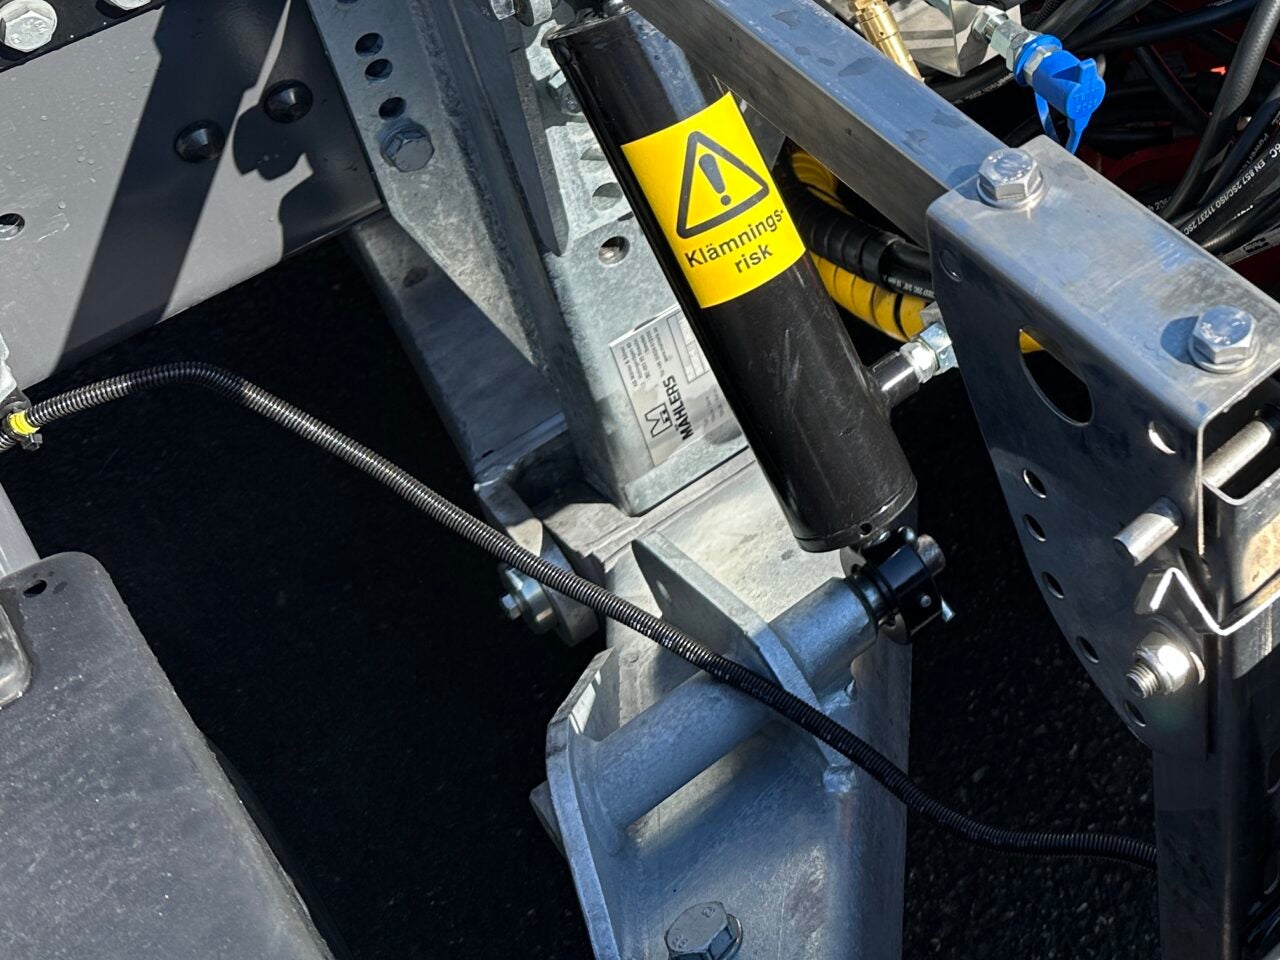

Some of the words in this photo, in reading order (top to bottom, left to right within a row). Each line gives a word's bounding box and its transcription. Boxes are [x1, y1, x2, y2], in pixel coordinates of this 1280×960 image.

[1254, 159, 1266, 173] EN
[684, 209, 784, 268] Klämnings-
[735, 244, 774, 273] risk
[663, 375, 694, 440] MÄHLERS
